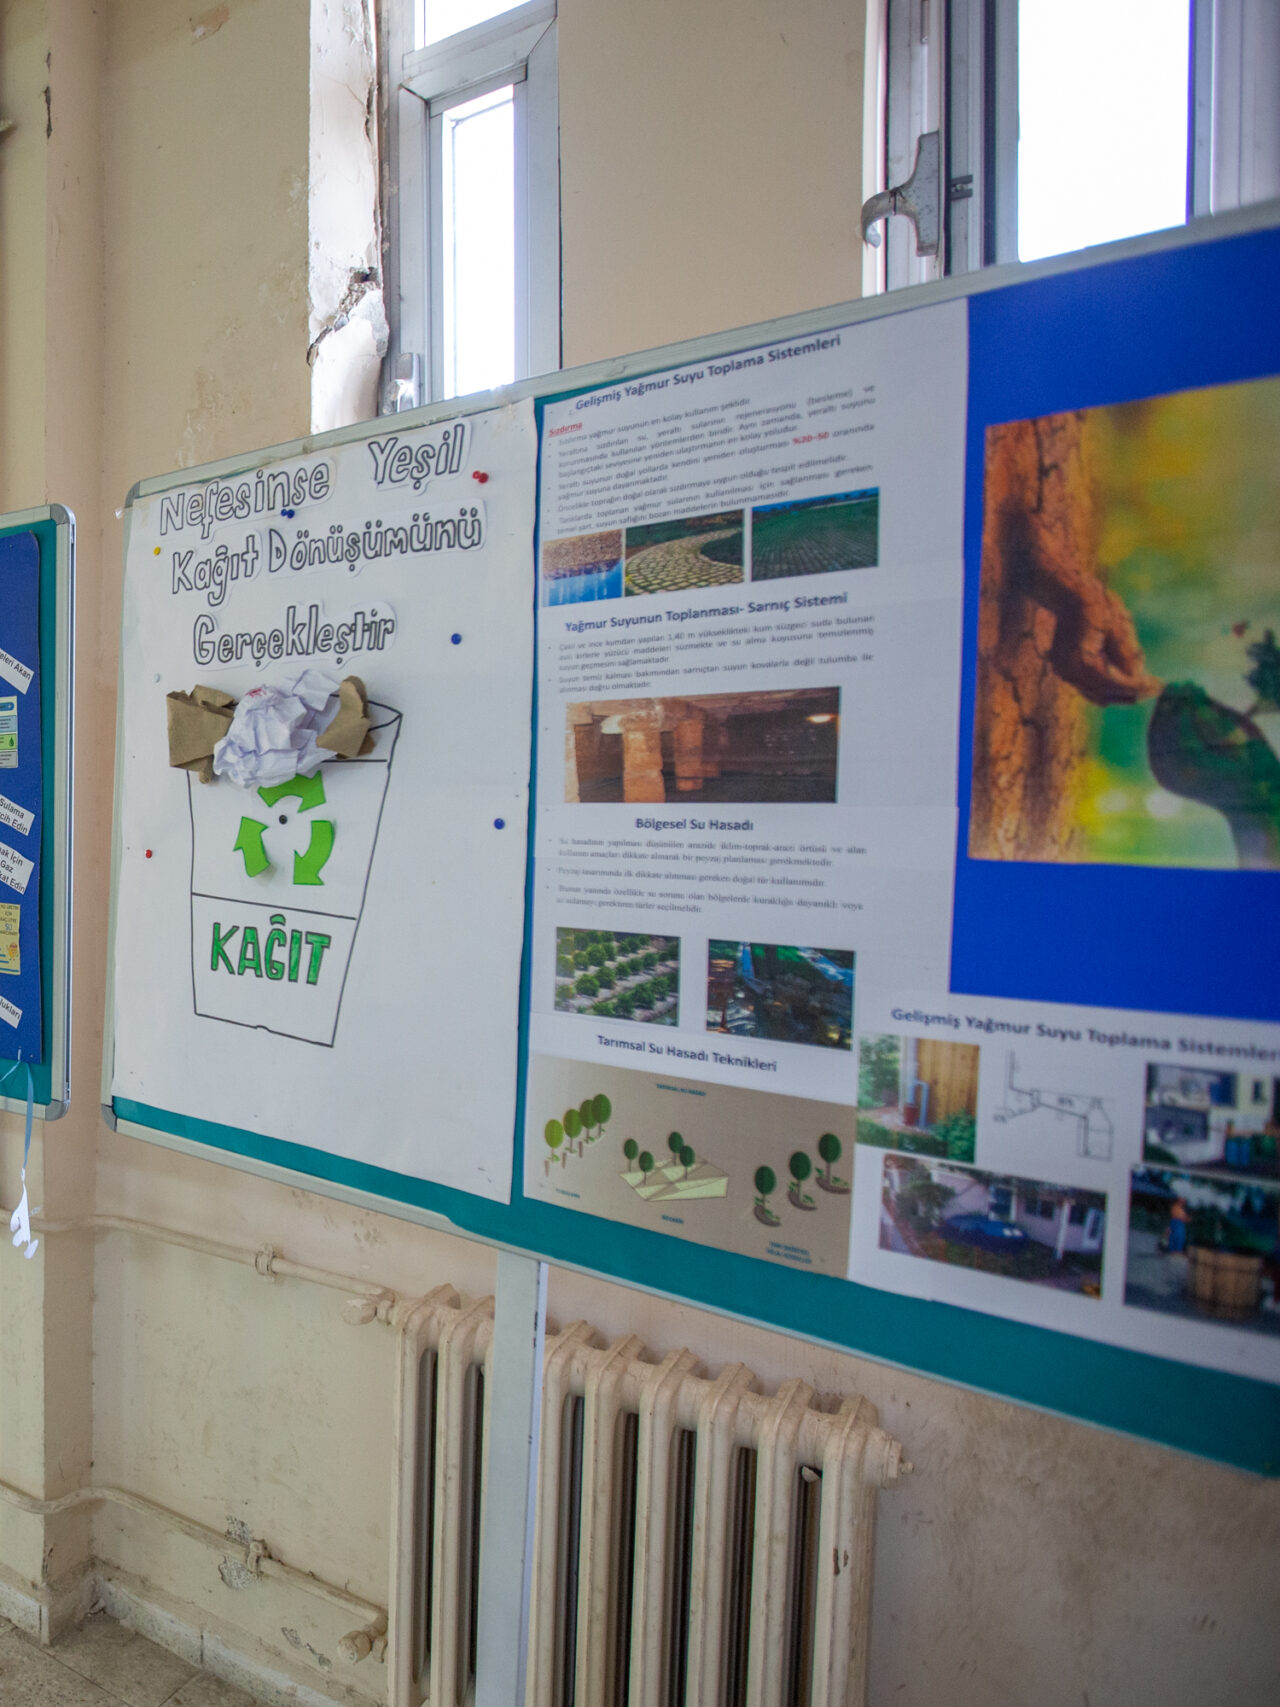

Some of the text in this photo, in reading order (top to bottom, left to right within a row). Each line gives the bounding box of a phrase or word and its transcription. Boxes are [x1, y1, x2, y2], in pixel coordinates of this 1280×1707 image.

[575, 334, 842, 411] Gelişmiş Yağmur Suyu Toplama Sistemleri
[549, 422, 583, 437] Sızdırma
[368, 423, 465, 491] Yeşil
[171, 508, 482, 607] Kağıt Dönüşümünü
[565, 620, 607, 633] Yağmur
[610, 613, 662, 629] Suyunun
[748, 601, 790, 613] Sarnıç
[794, 591, 848, 609] Sistemi
[193, 604, 396, 667] Gerçekleştir
[14, 664, 31, 680] Akan
[0, 798, 25, 819] Sulama
[11, 819, 28, 834] Edin
[636, 818, 754, 831] Bölgesel Su Hasadı
[0, 859, 15, 874] Gaz
[11, 851, 23, 867] İçin
[10, 878, 25, 893] Edin
[891, 1008, 961, 1030] Gelişmiş
[965, 1016, 1030, 1035] Yağmur
[1036, 1024, 1082, 1042] Suyu
[1088, 1028, 1171, 1049] Toplama
[597, 1035, 777, 1072] Tarımsal Su Hasadı Teknikleri
